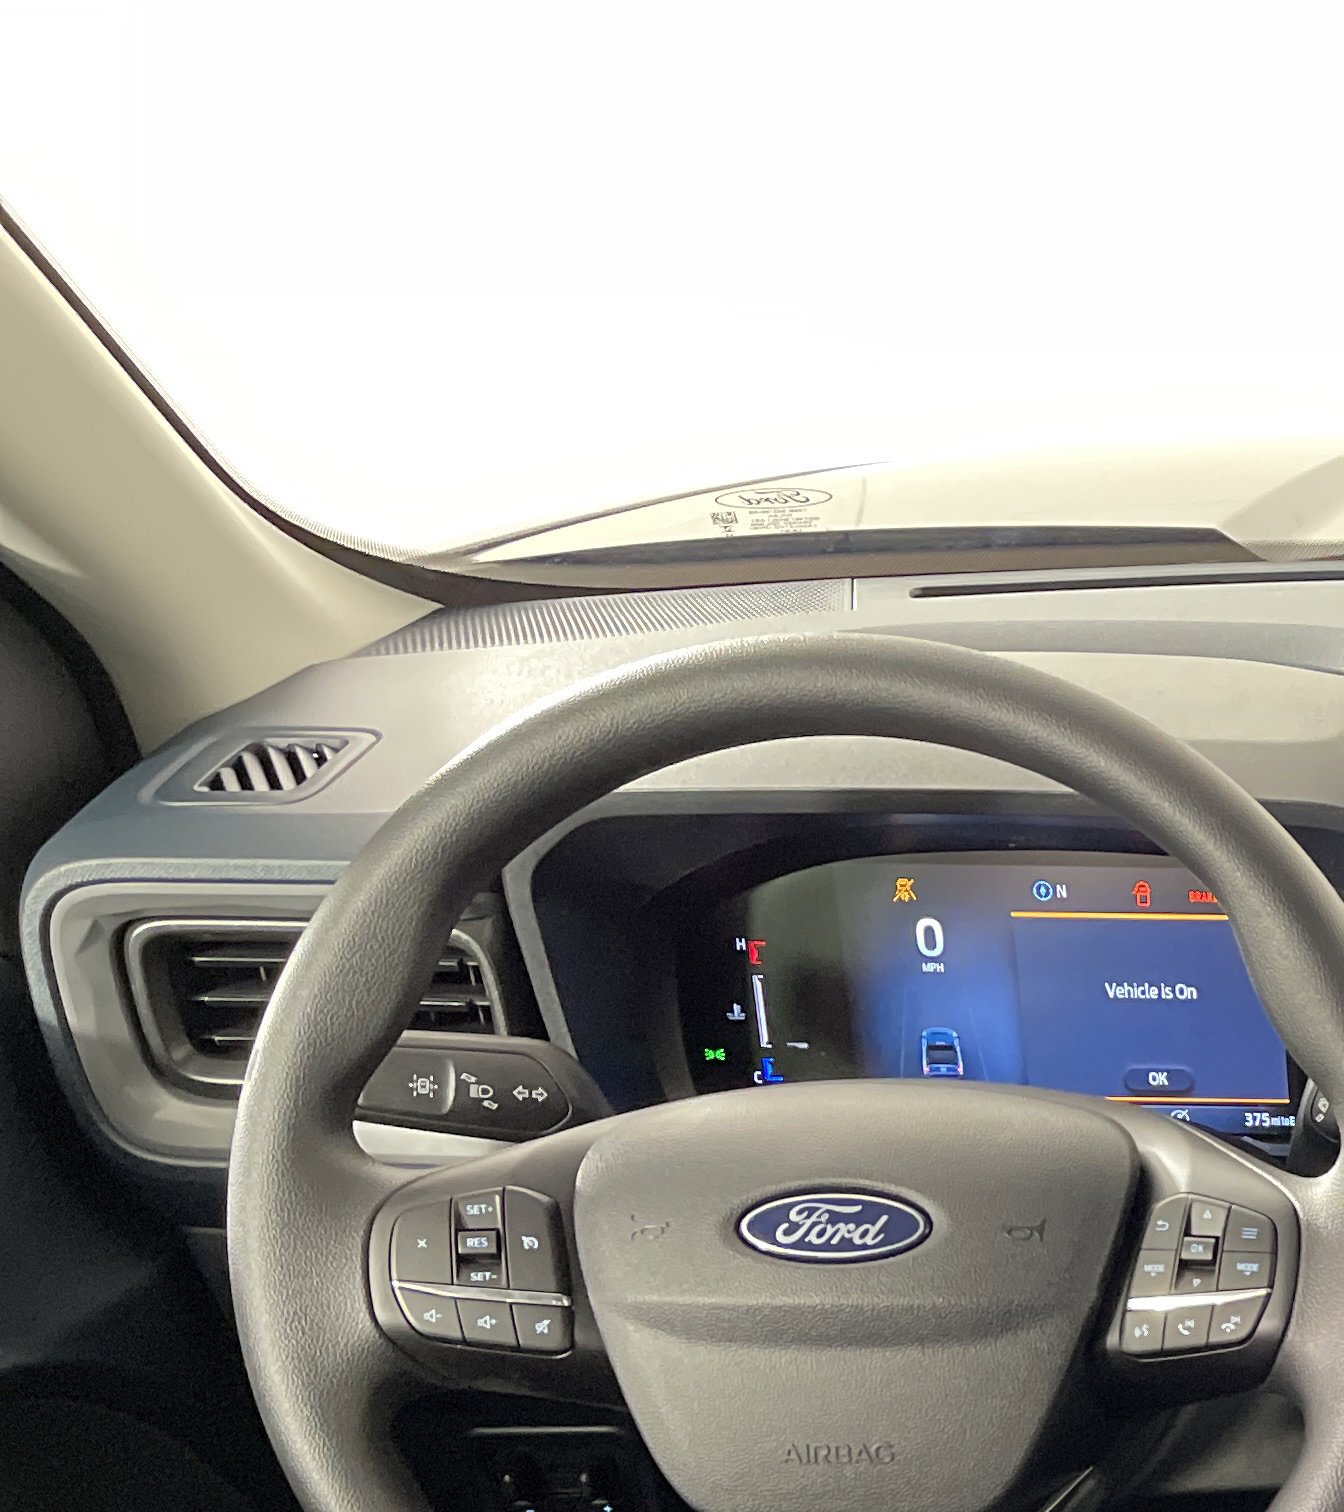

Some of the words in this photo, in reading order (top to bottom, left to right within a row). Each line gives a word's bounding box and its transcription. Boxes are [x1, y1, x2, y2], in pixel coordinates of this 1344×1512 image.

[1056, 884, 1067, 899] N
[735, 938, 746, 951] H
[915, 917, 944, 957] 0
[922, 962, 944, 973] MPH
[1104, 982, 1158, 999] Vehicle
[1175, 983, 1198, 1000] On
[754, 1071, 762, 1083] C
[1148, 1071, 1168, 1086] OK
[1244, 1112, 1270, 1127] 375
[775, 1202, 890, 1246] Ford
[466, 1236, 489, 1248] RES
[784, 1442, 897, 1465] AIRBAG
